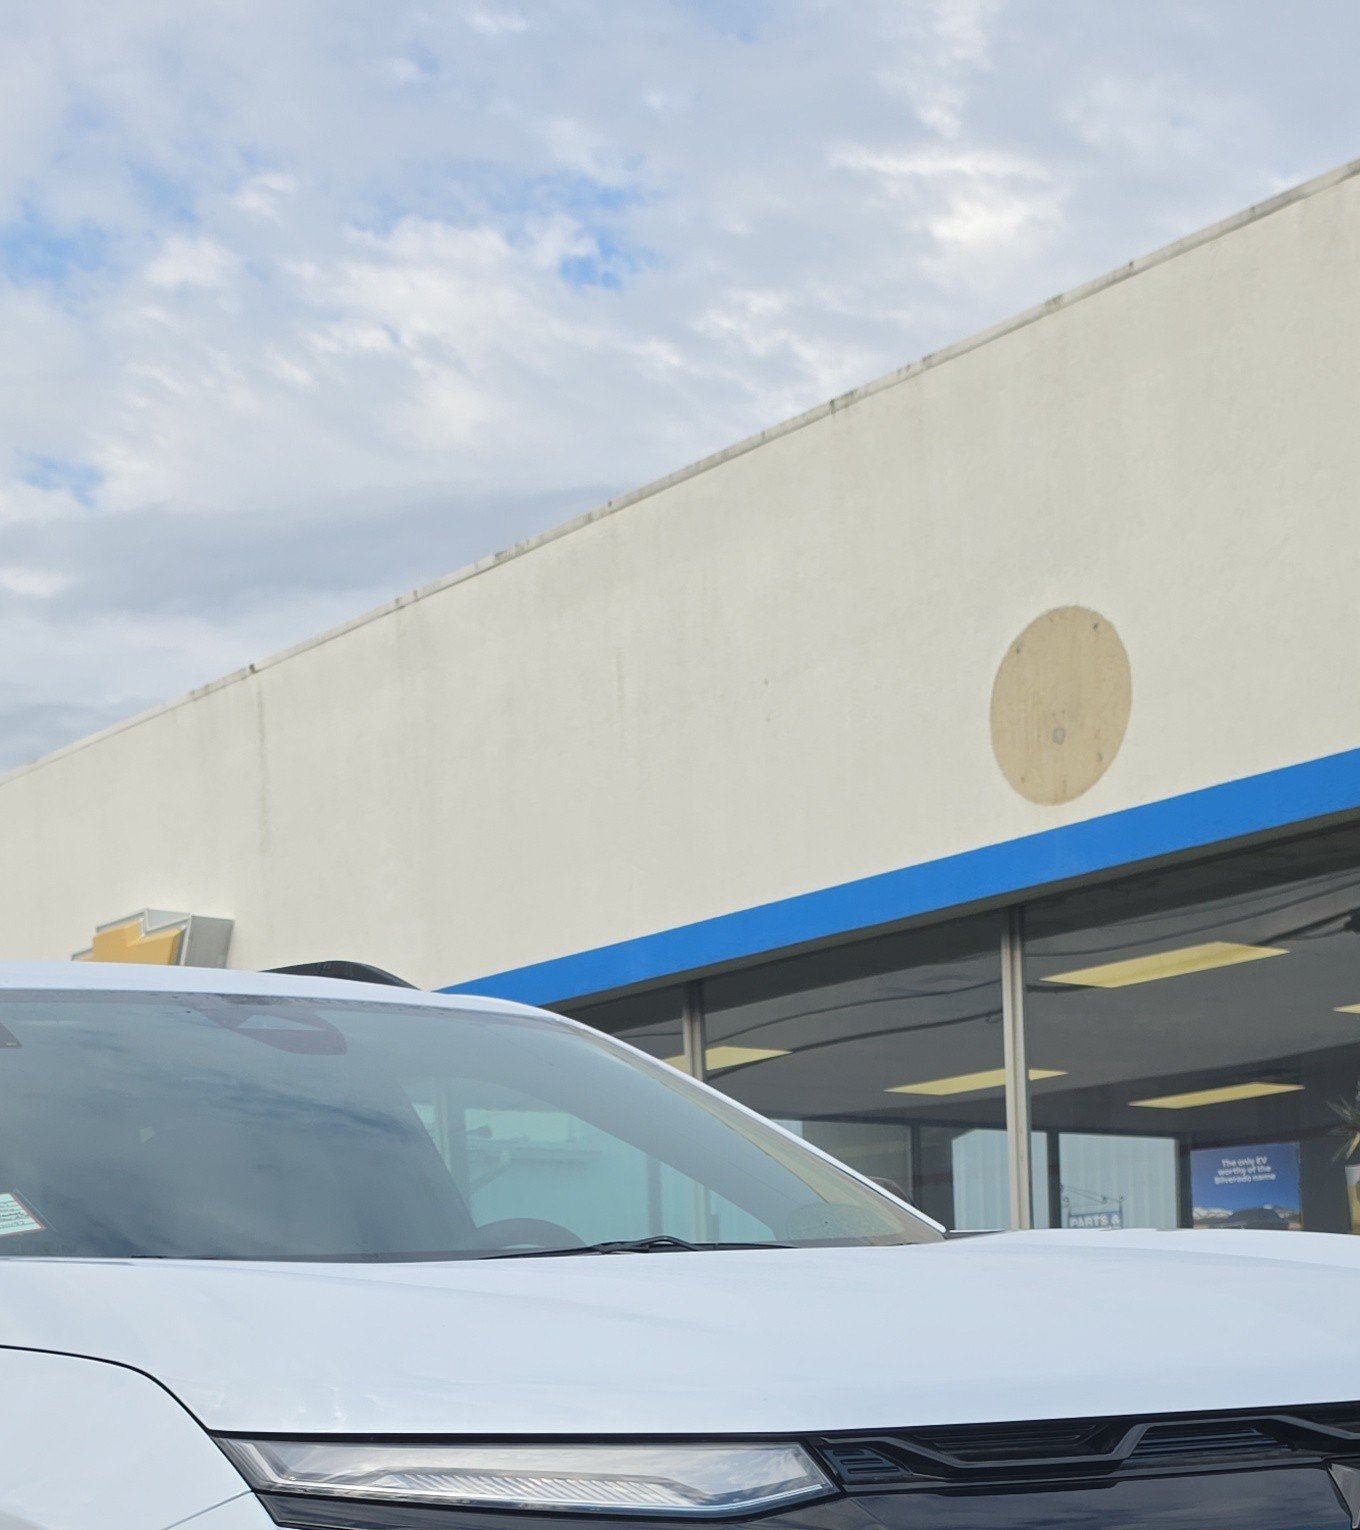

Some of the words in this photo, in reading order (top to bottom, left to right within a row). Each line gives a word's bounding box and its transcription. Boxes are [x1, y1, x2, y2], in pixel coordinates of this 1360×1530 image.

[1222, 1159, 1237, 1167] The
[1237, 1157, 1255, 1167] only
[1256, 1156, 1267, 1164] EV
[1218, 1167, 1246, 1176] worthy
[1214, 1176, 1251, 1184] Silverado
[1252, 1173, 1276, 1181] name
[1069, 1214, 1108, 1227] PARTS
